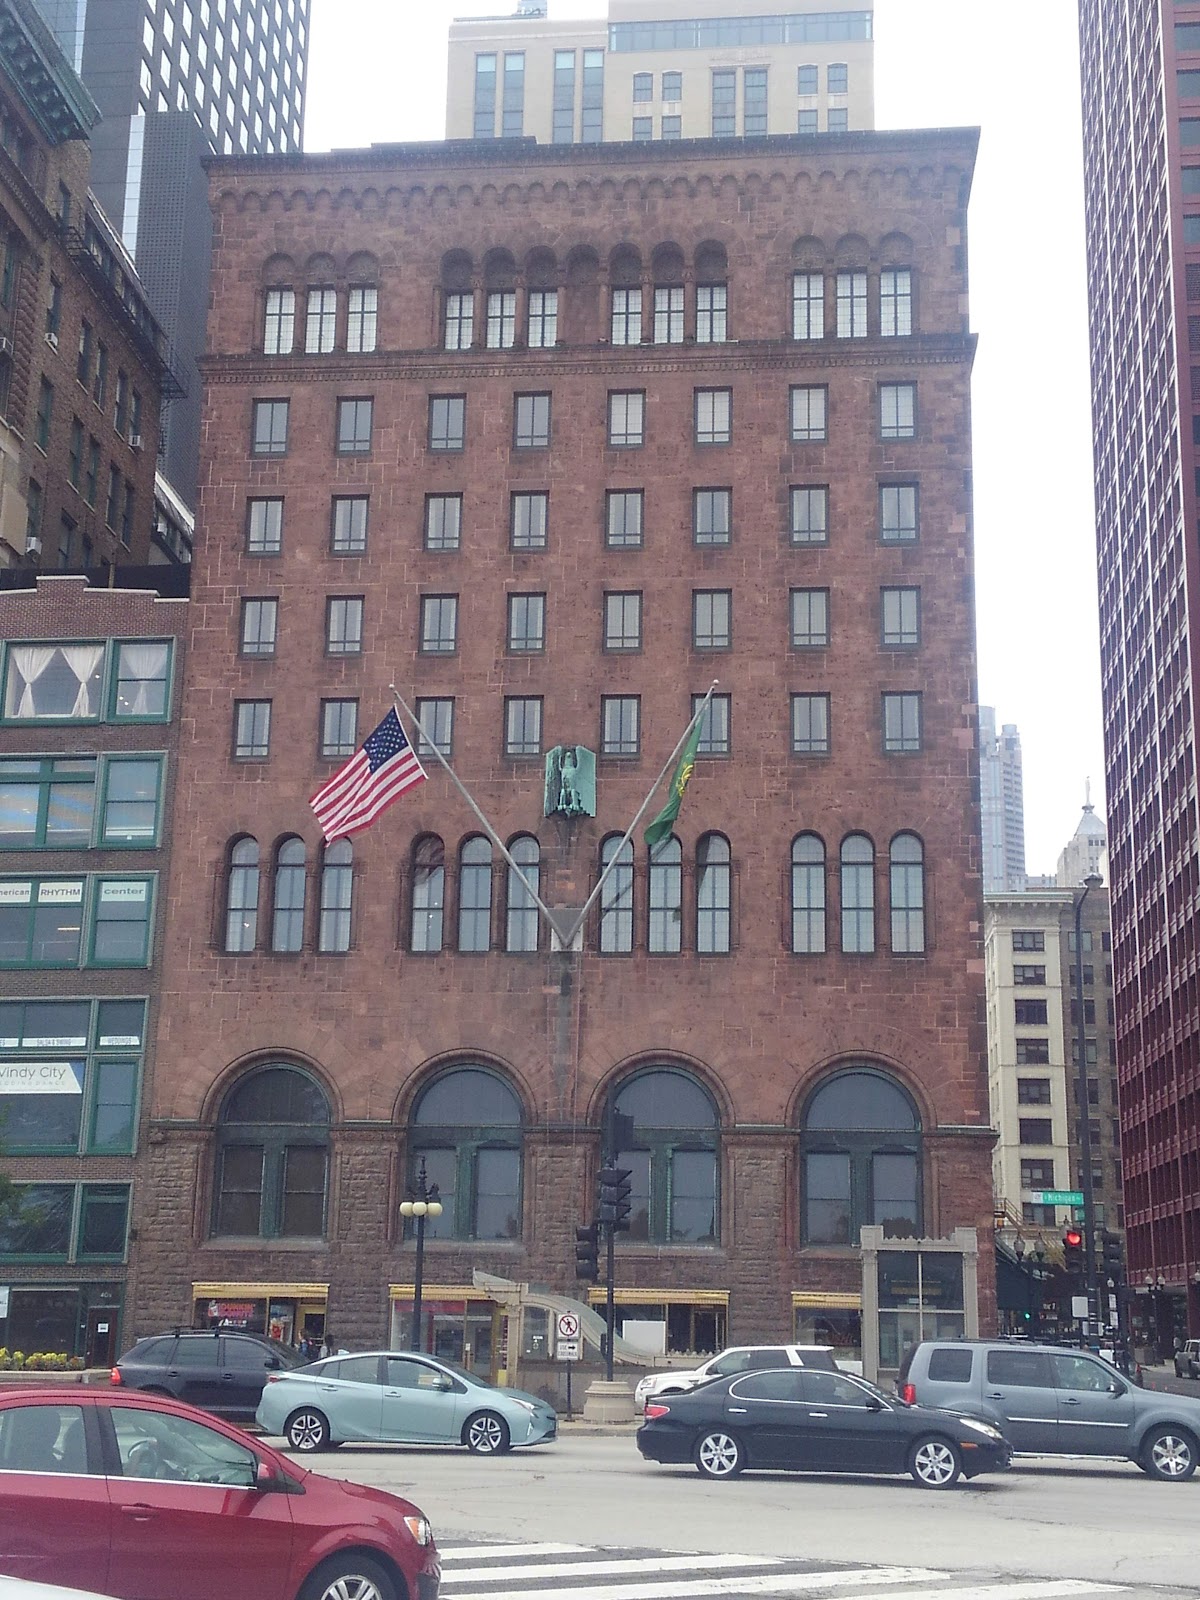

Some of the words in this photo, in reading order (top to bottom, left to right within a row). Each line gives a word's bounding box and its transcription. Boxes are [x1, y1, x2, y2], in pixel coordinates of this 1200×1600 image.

[40, 888, 81, 896] RHYTHM
[40, 1066, 66, 1080] City
[1047, 1193, 1075, 1203] Michigan
